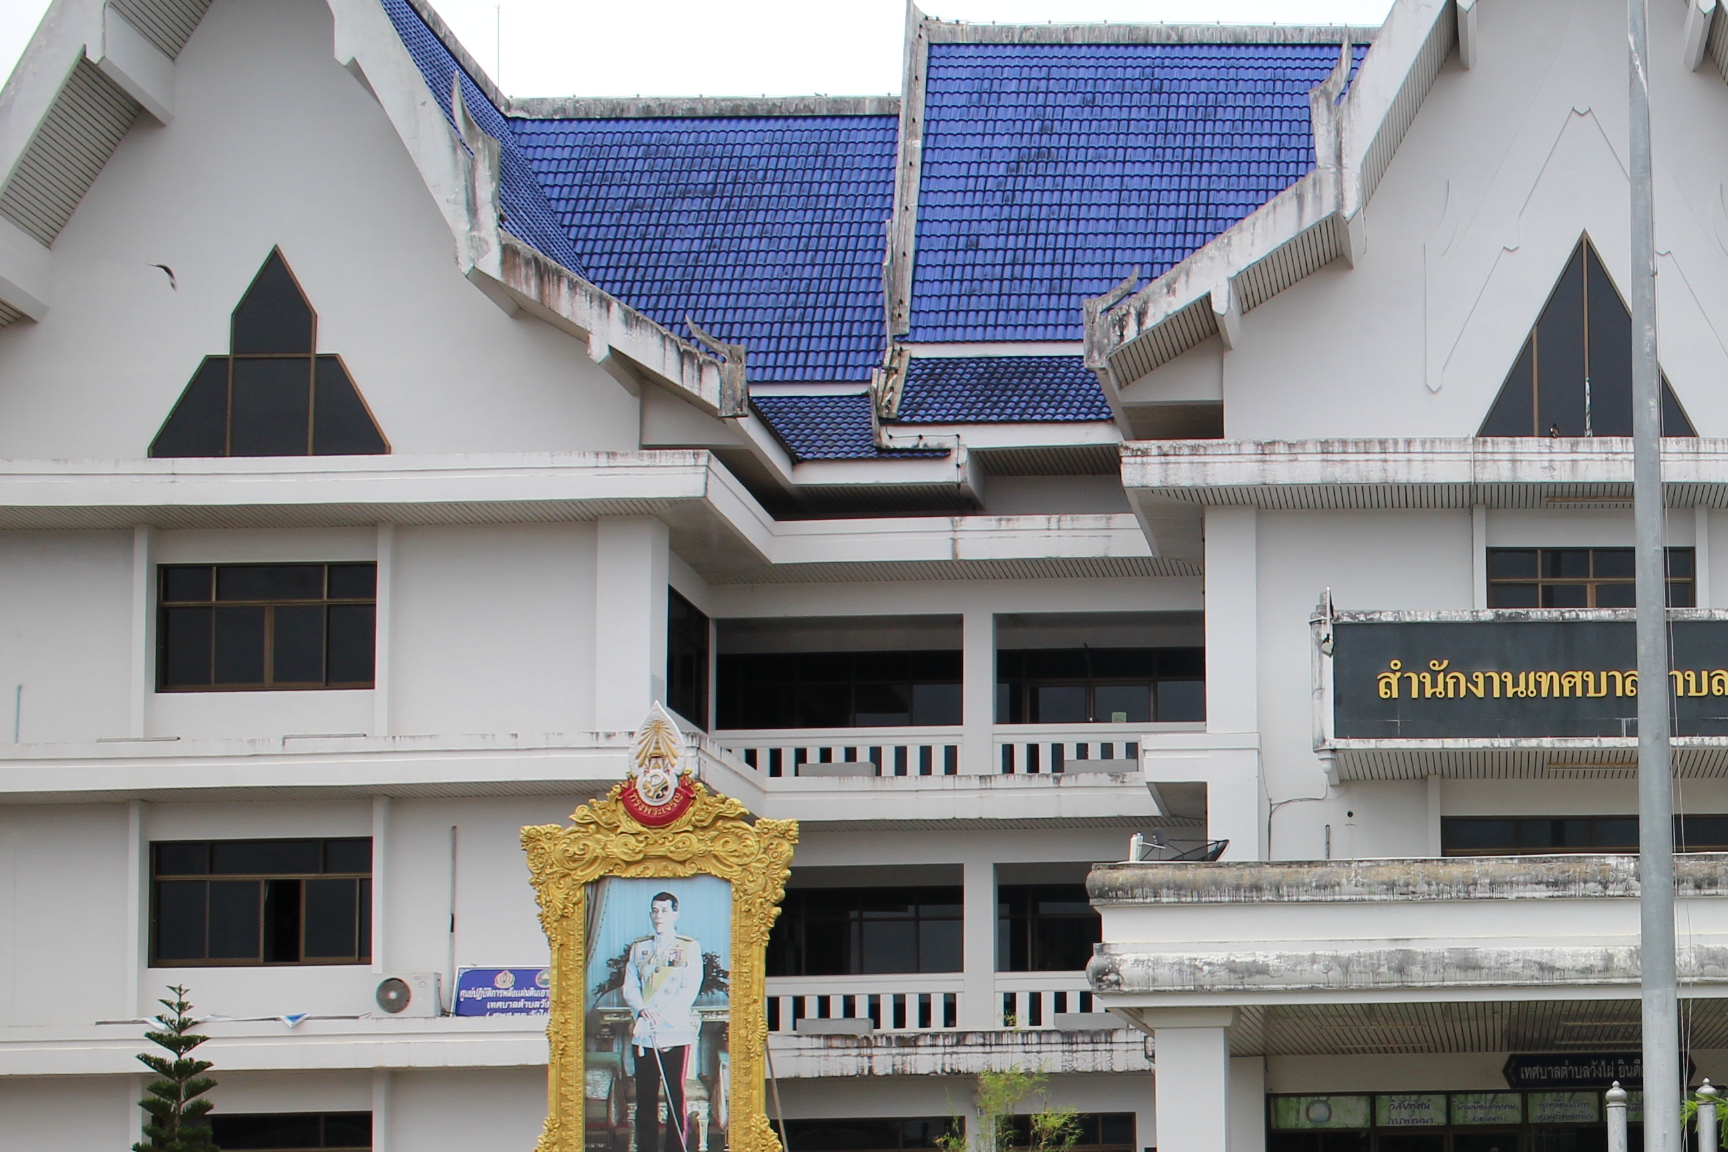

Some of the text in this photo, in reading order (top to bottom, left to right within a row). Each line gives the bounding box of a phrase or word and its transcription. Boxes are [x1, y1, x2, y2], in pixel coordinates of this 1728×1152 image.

[459, 987, 549, 1001] ศูนย์ปฏิบัติการพลังแผ่นดินเอา
[486, 998, 549, 1009] เทศบาลตำบลวัง
[1520, 1059, 1614, 1080] เทศบาลตำบลวังไผ่
